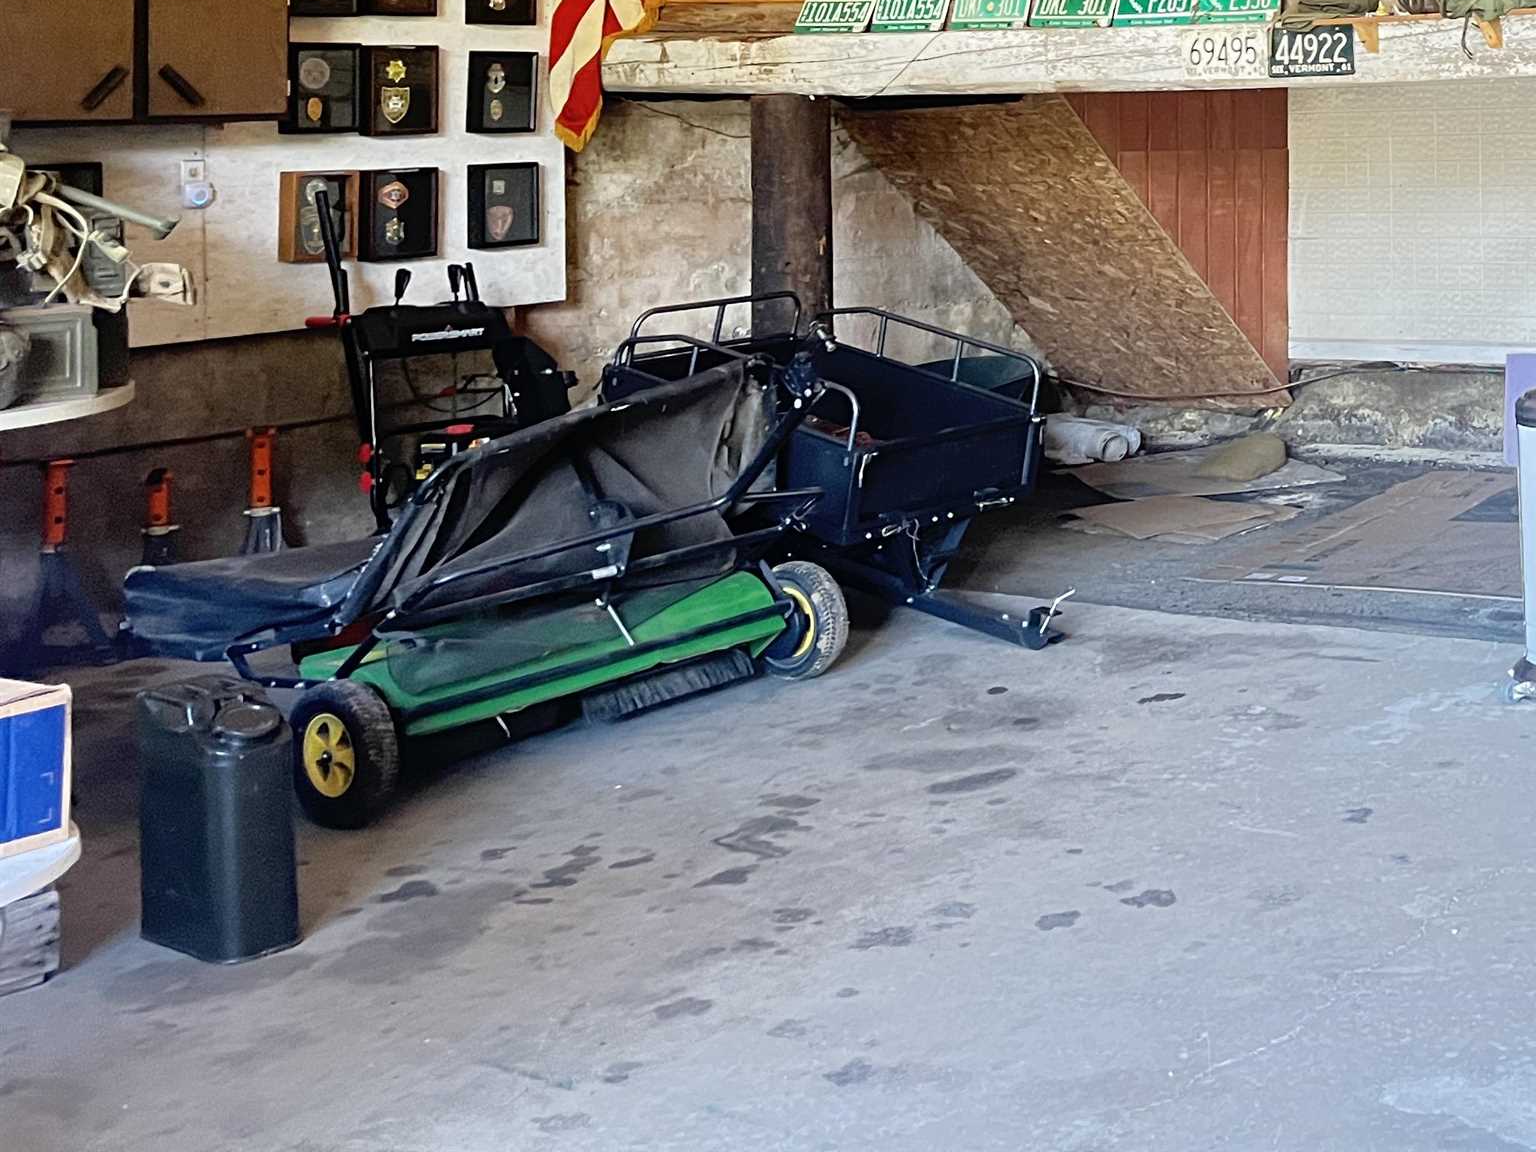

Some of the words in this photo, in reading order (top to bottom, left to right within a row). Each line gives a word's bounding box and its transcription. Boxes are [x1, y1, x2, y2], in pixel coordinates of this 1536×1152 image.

[804, 1, 871, 23] 101A554
[1189, 36, 1258, 66] 69495
[1274, 32, 1349, 65] 44922
